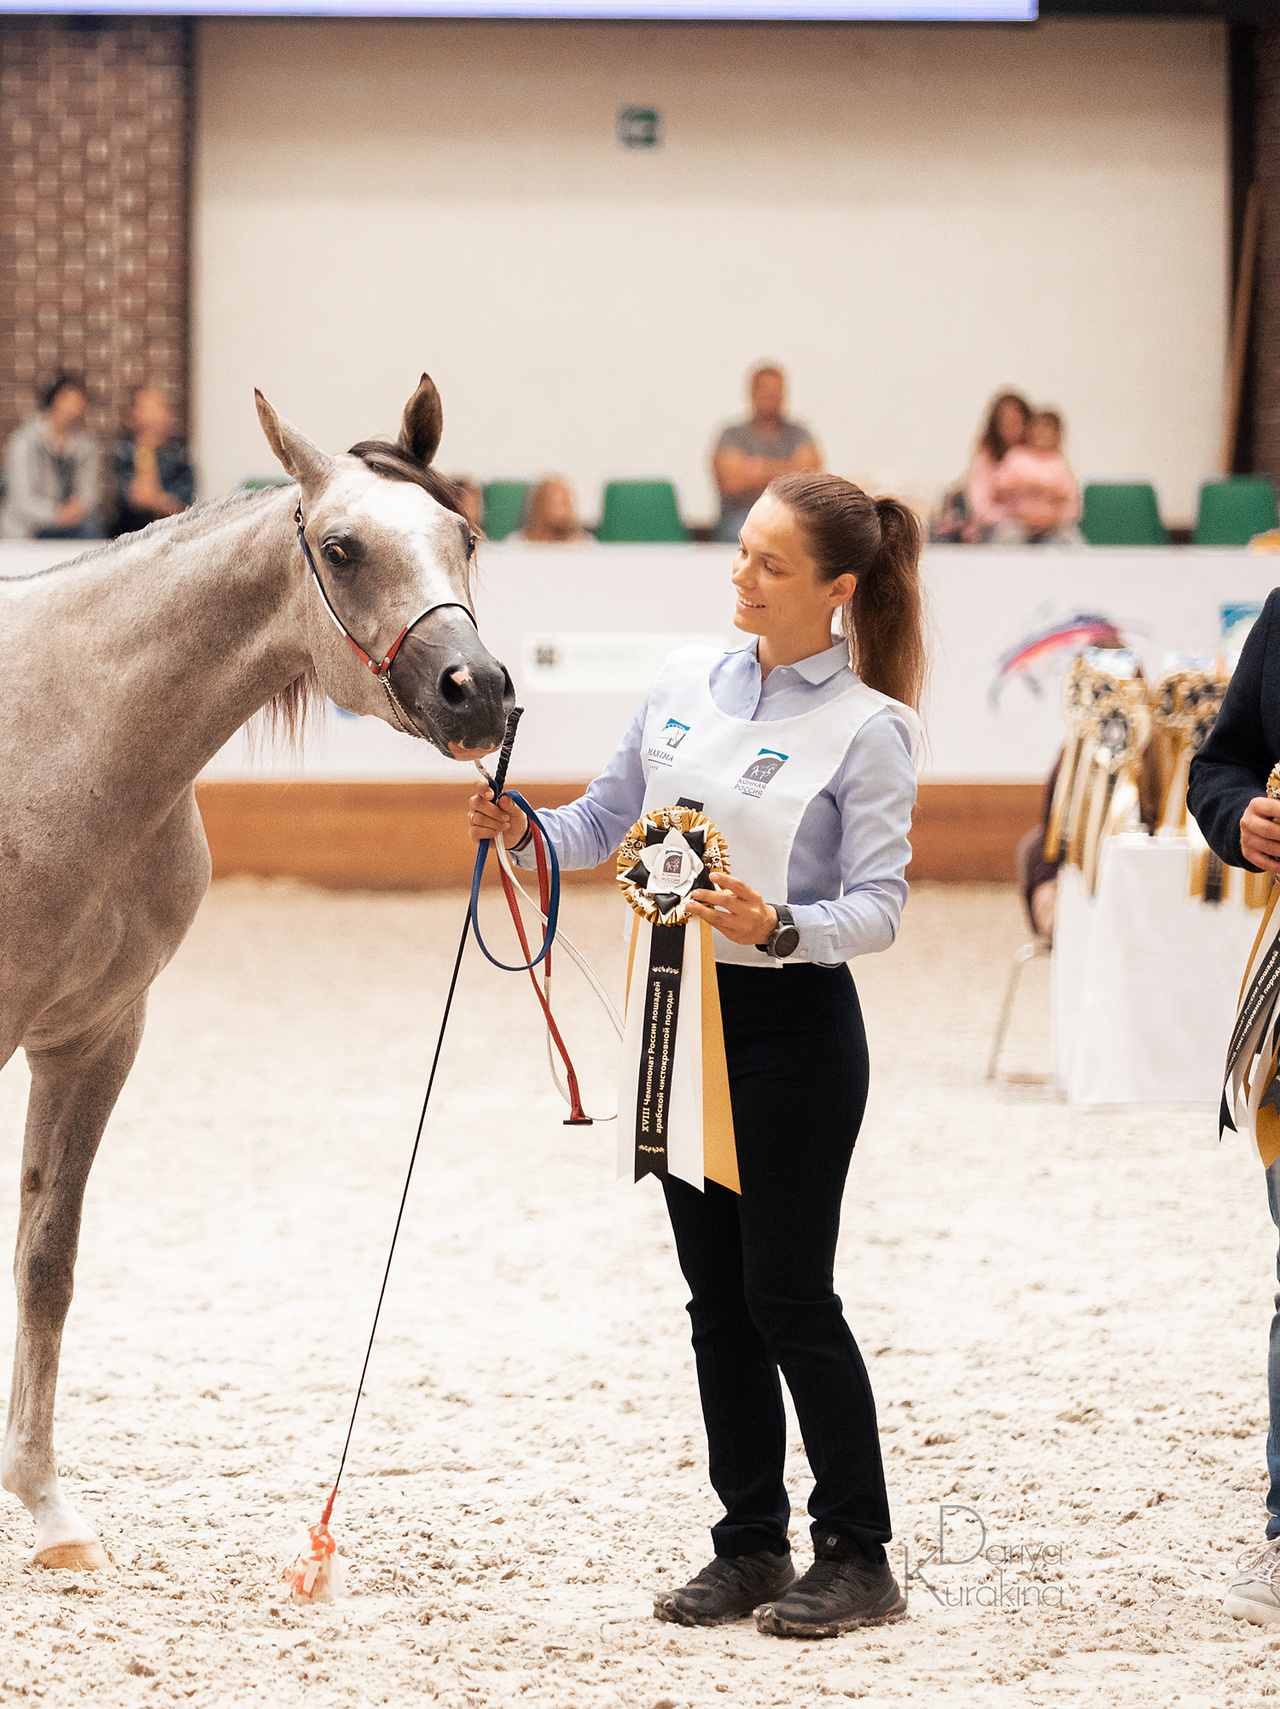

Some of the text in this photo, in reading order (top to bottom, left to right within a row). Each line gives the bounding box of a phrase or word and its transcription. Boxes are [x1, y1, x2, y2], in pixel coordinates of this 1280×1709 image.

[648, 748, 674, 762] MAXIMA
[734, 784, 763, 797] РОССИЯ
[738, 778, 767, 790] КОННАЯ
[1257, 950, 1279, 987] лошадей
[641, 981, 662, 1133] XVIII Чемпионат России лошадей
[654, 990, 675, 1135] арабской чистокровной породы
